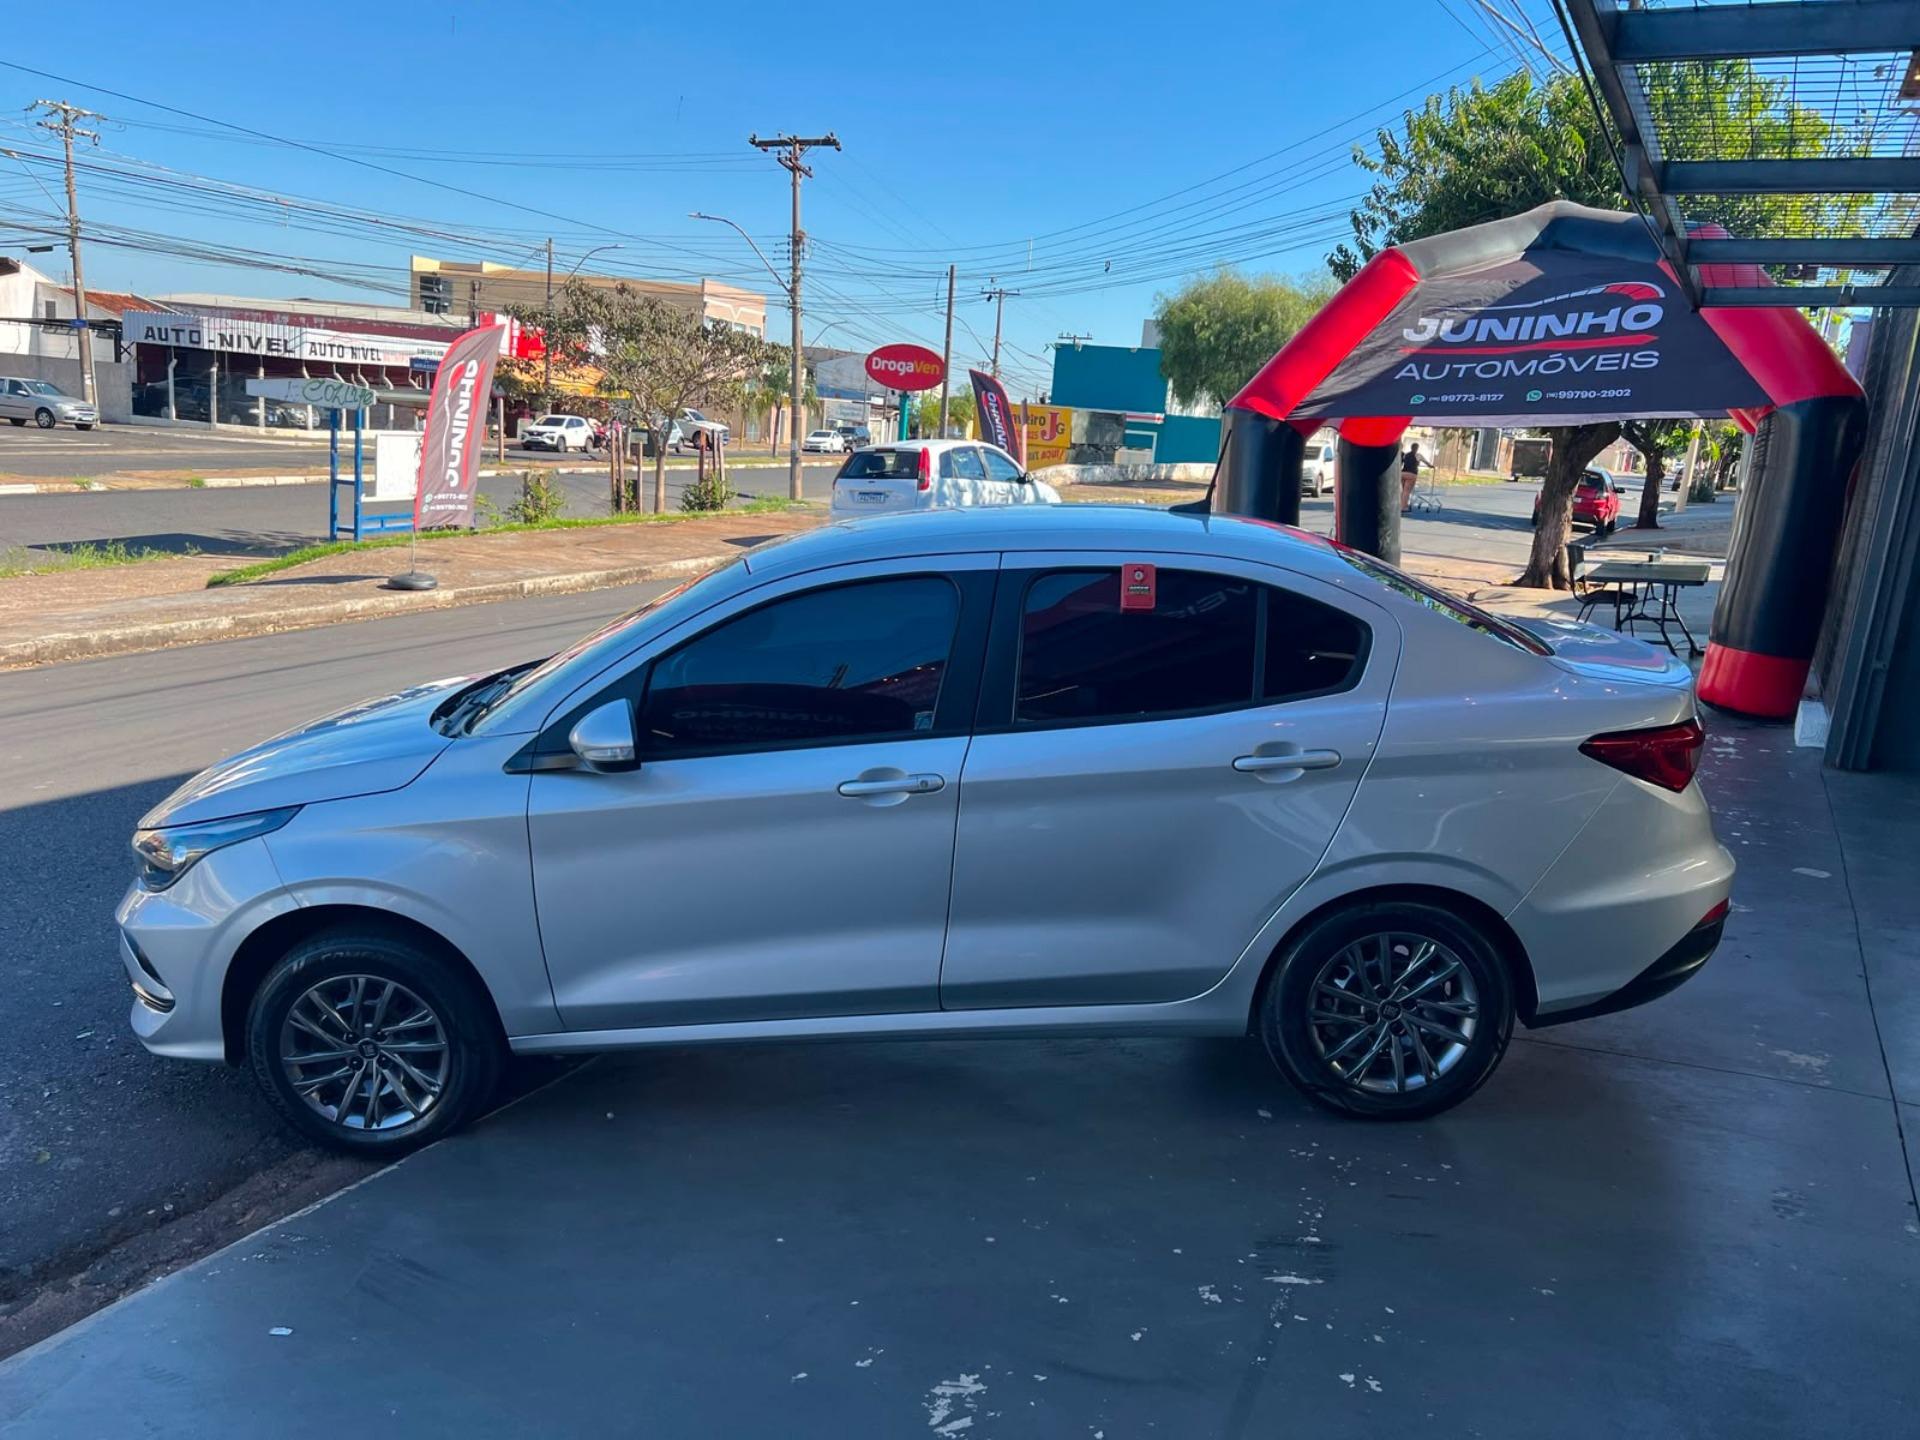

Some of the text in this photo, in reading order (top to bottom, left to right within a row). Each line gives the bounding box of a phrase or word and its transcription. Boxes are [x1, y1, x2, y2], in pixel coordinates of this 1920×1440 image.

[144, 326, 200, 345] AUTO
[1403, 304, 1664, 342] JUNINHO
[309, 342, 344, 359] AUTO
[872, 357, 940, 376] DrogaVen
[1394, 350, 1660, 381] AUTOMÓVEIS
[445, 359, 479, 487] JUNINHO
